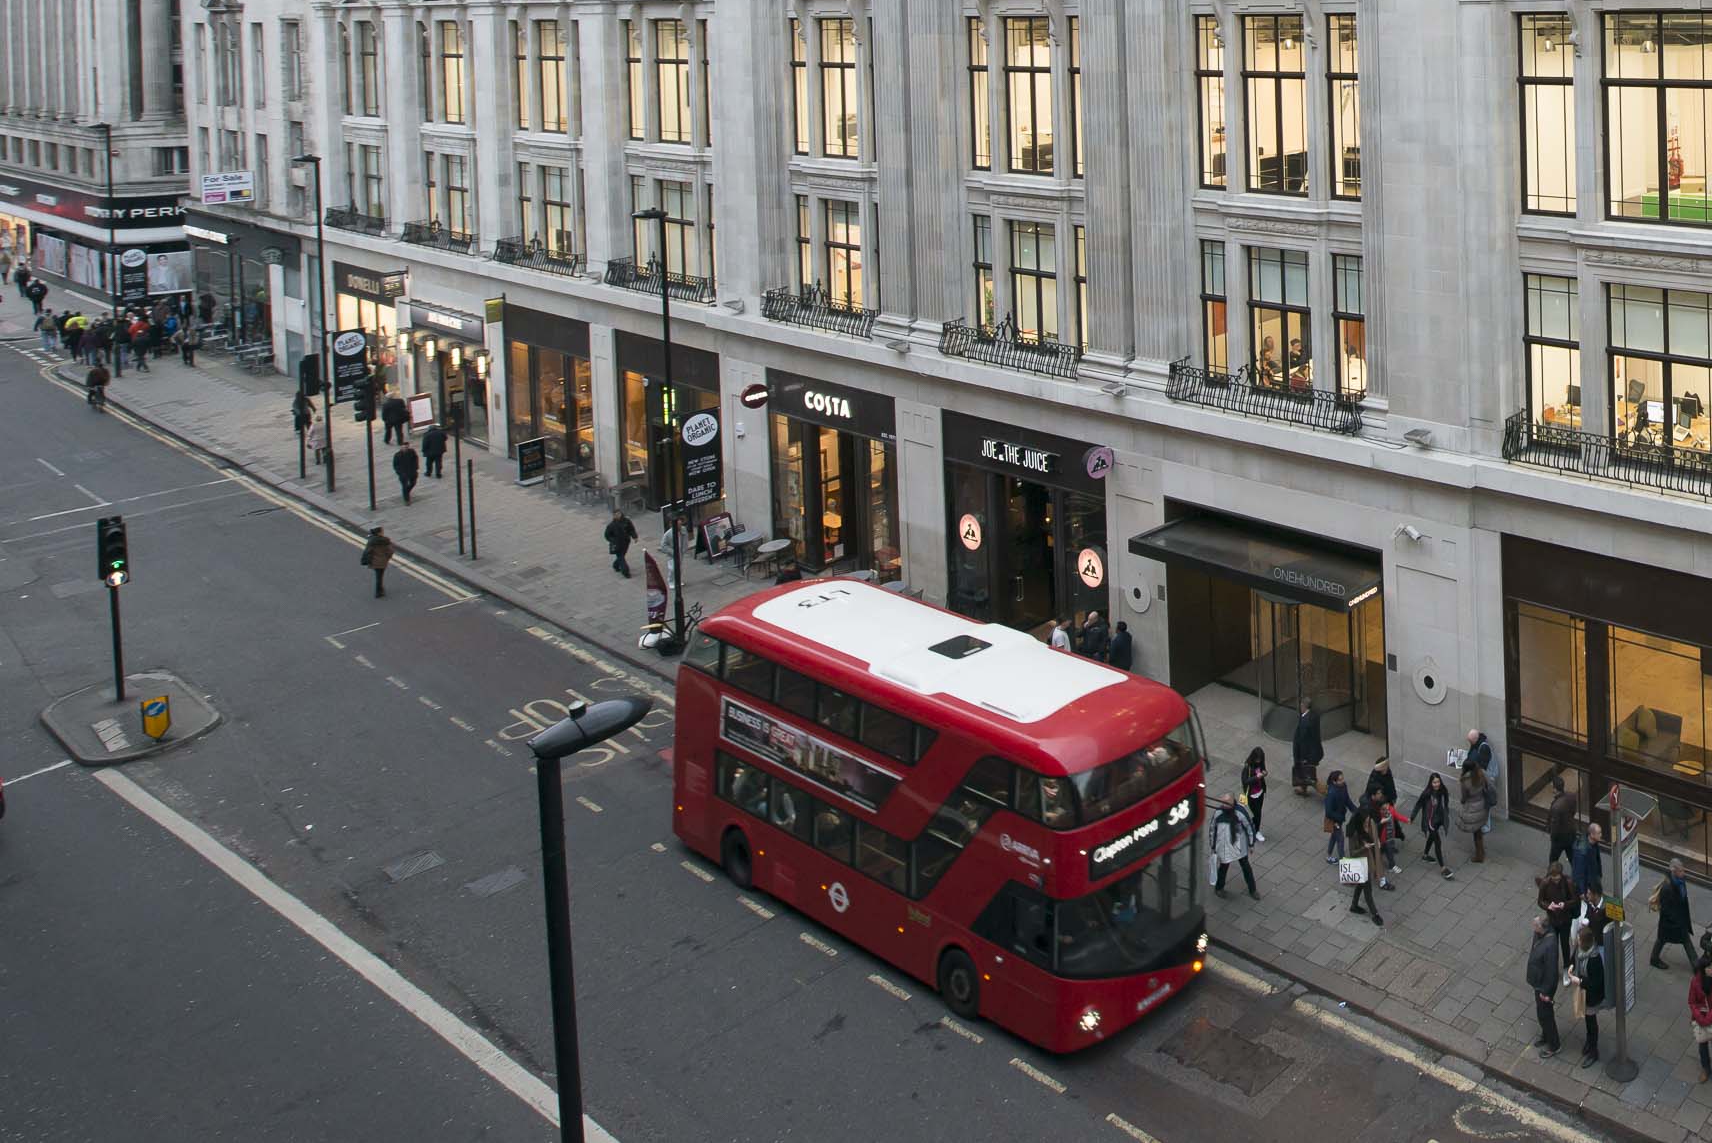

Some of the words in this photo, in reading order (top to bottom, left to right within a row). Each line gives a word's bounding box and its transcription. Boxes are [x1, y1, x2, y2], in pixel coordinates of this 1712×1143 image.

[203, 175, 220, 183] For
[222, 173, 243, 182] Sale
[804, 390, 851, 418] COSTA
[686, 417, 711, 434] PLANET
[687, 423, 716, 442] ORGANIC
[981, 439, 998, 459] JOE
[1003, 444, 1020, 465] THE
[1022, 449, 1049, 473] JUICE
[1273, 567, 1346, 596] ONEHUNDRED
[728, 706, 762, 730] BUSINESS
